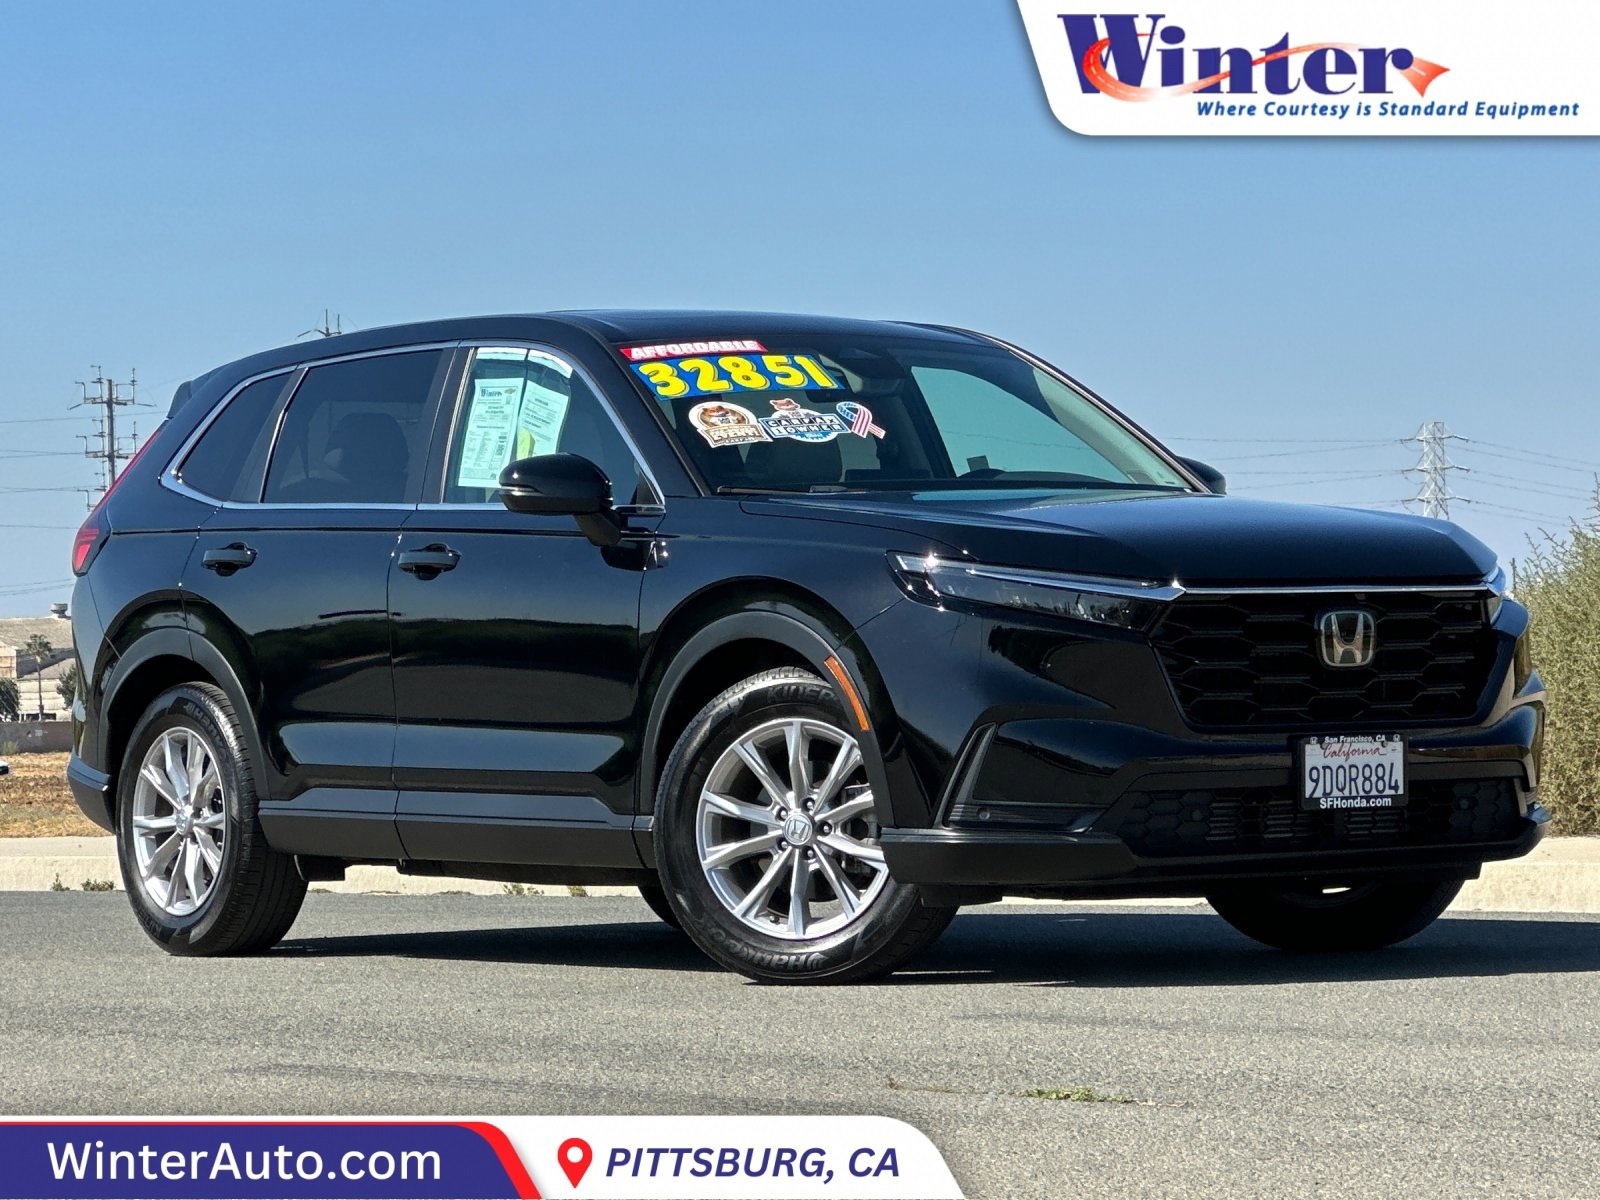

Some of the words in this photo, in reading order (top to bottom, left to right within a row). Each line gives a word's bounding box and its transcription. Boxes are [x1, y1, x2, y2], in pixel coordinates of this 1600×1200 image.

[630, 340, 759, 360] AFFORDABLE
[638, 355, 839, 397] 32851
[767, 416, 838, 427] CARFAX
[1324, 736, 1339, 744] San
[1339, 735, 1375, 745] Francisco,
[1375, 734, 1387, 743] CA
[1322, 743, 1387, 763] California
[1308, 762, 1400, 799] 9DQR884
[1319, 797, 1393, 810] SFHonda.com
